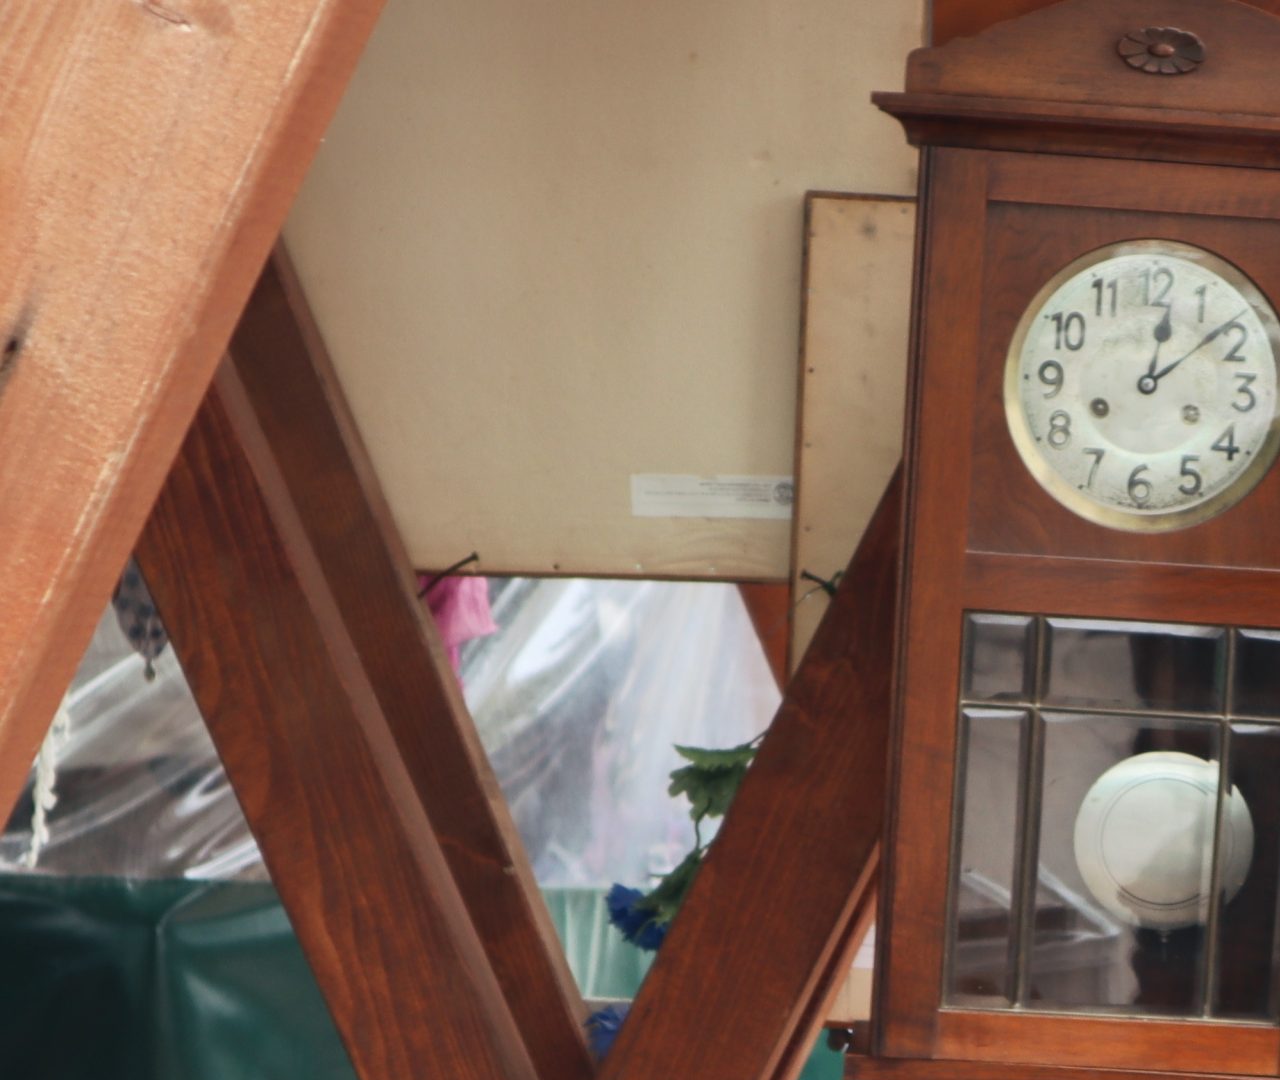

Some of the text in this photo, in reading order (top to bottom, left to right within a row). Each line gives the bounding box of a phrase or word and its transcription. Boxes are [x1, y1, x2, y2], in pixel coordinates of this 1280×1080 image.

[1091, 277, 1118, 318] 11
[1140, 267, 1175, 308] 12
[1195, 284, 1207, 323] 1
[1049, 311, 1086, 351] 10
[1223, 321, 1247, 362] 2
[1038, 359, 1064, 399] 9
[1231, 371, 1257, 412] 3
[1047, 409, 1071, 450] 8
[1210, 425, 1240, 461] 4
[1082, 447, 1105, 488] 7
[1127, 463, 1153, 505] 6
[1178, 454, 1201, 496] 5
